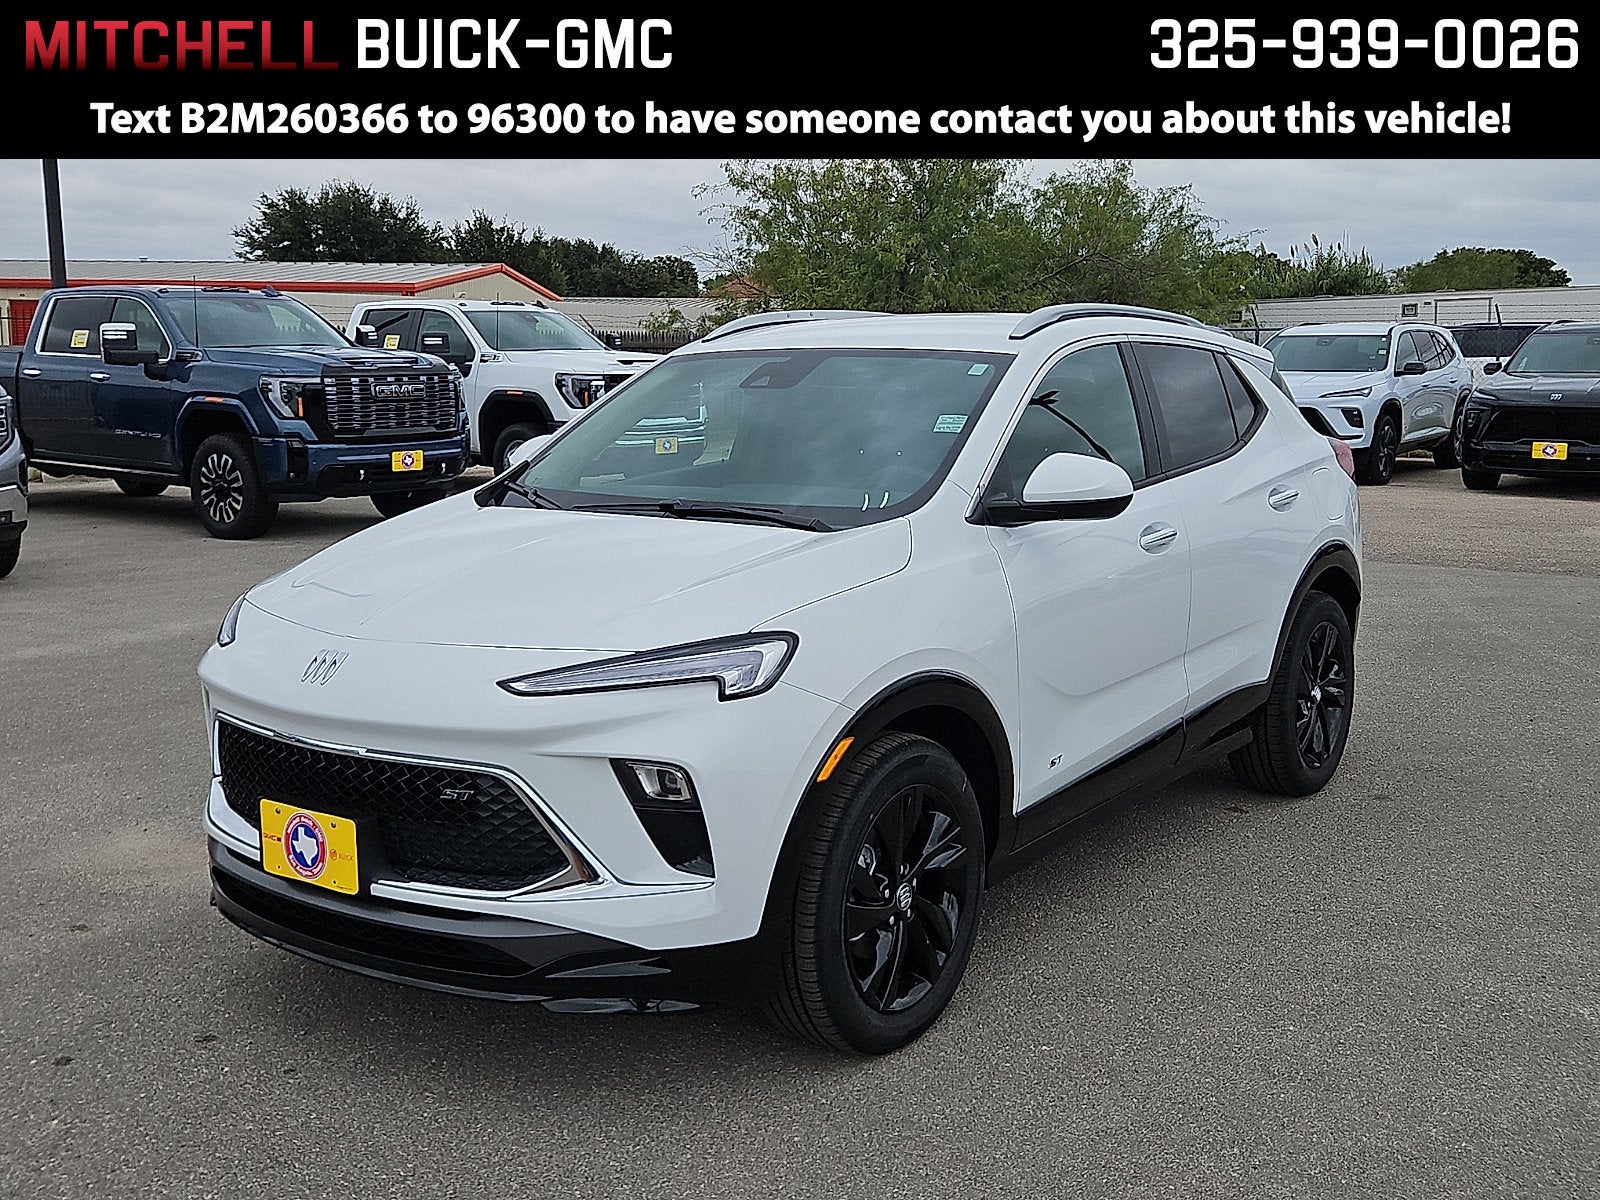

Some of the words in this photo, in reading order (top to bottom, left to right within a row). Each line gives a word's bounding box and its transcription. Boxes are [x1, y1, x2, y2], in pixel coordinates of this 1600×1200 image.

[376, 384, 425, 397] GMC
[1048, 754, 1063, 769] ST
[440, 788, 474, 801] ST
